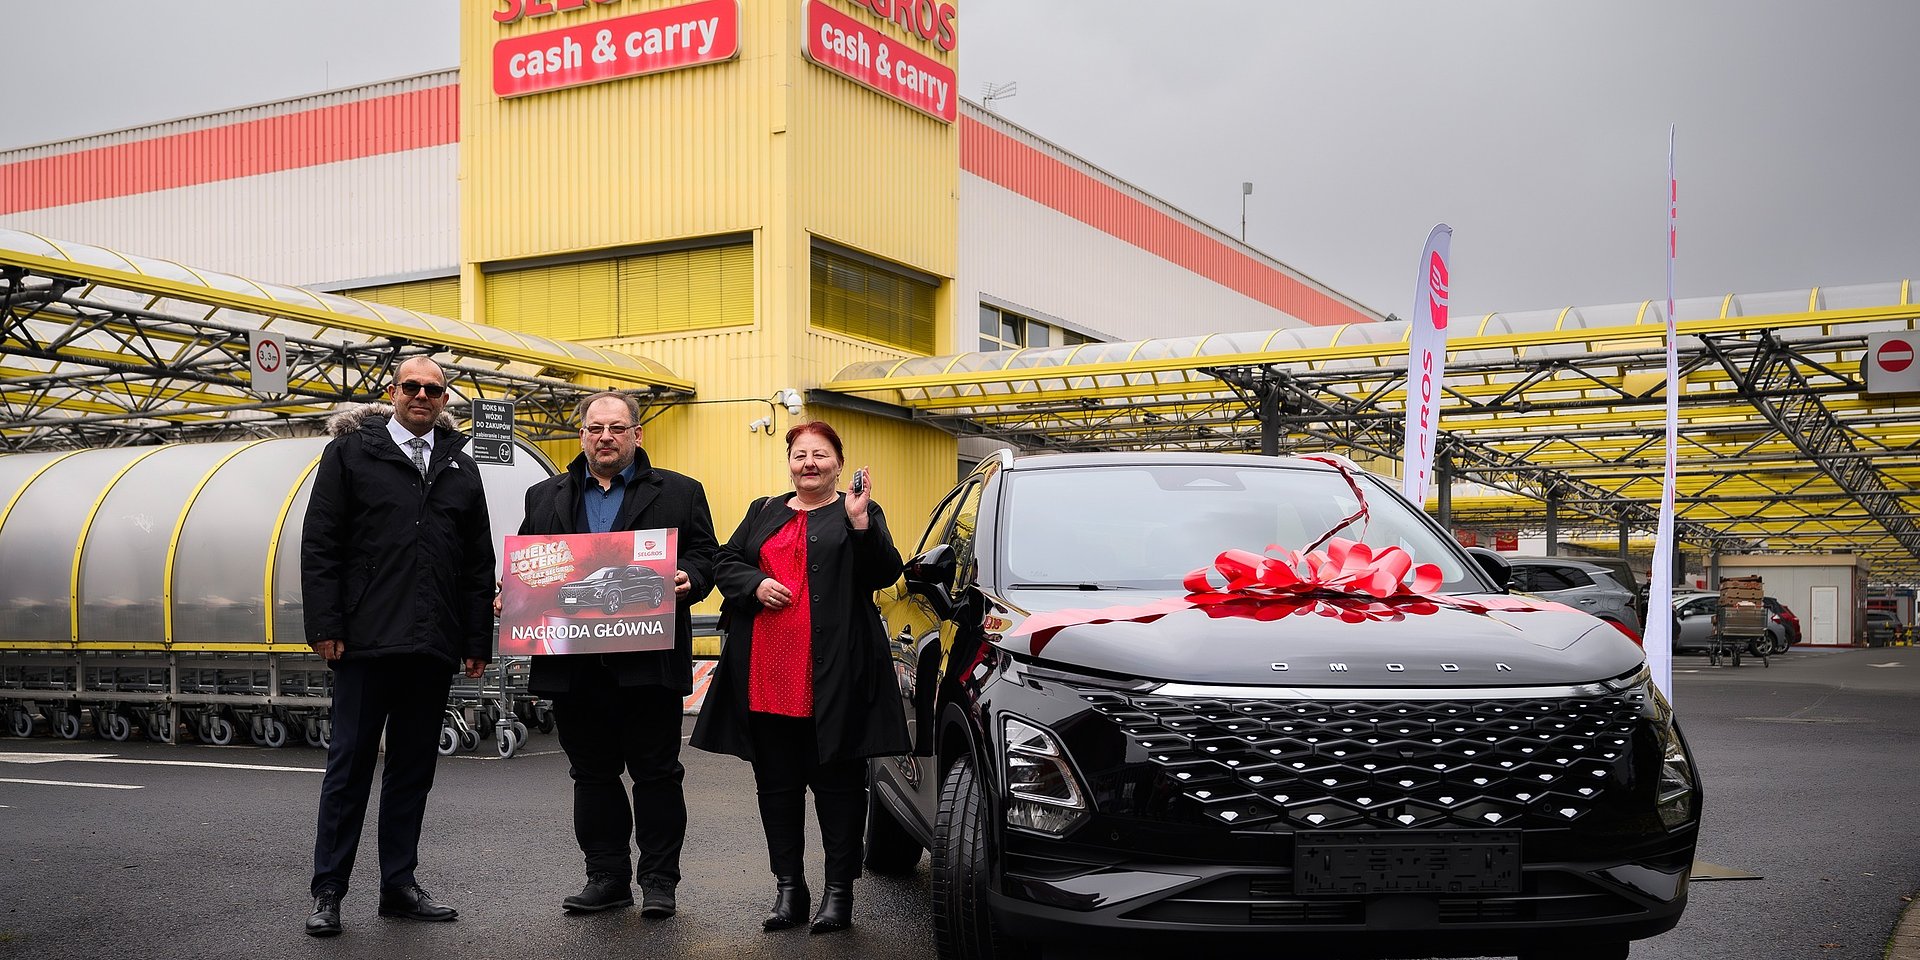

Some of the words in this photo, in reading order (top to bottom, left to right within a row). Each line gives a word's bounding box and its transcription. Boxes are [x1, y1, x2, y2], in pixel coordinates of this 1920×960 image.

[509, 36, 583, 79] cash
[591, 29, 617, 64] &
[624, 17, 719, 55] carry
[820, 23, 871, 69] cash
[875, 43, 892, 79] &
[895, 60, 948, 112] carry
[482, 403, 497, 411] BOKS
[485, 412, 502, 421] WÓZKI
[485, 422, 511, 430] ZAKUPÓW
[510, 540, 570, 562] WIELKA
[637, 550, 663, 558] SELGROS
[509, 549, 575, 575] LOTERIA
[511, 624, 591, 640] NAGRODA
[594, 620, 664, 638] GŁÓWNA
